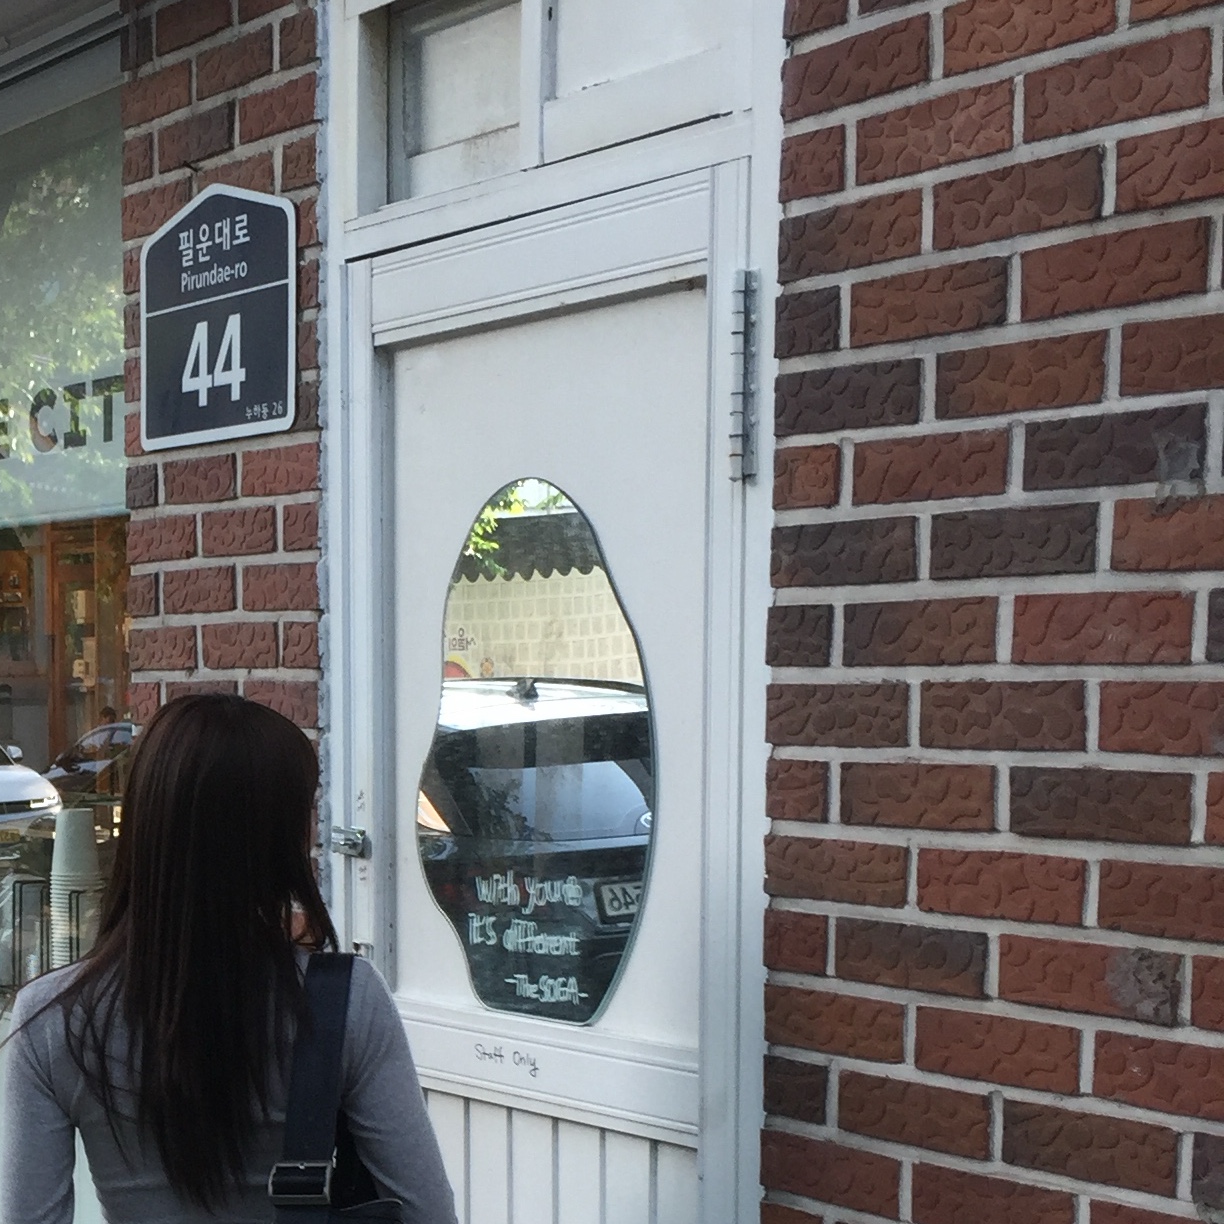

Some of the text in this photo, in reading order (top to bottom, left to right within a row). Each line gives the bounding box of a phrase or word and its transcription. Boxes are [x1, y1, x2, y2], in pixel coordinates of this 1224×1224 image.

[178, 213, 251, 267] 필운대로
[181, 260, 248, 293] Pirundae-ro
[181, 312, 246, 408] 44
[272, 401, 284, 416] 26
[474, 1043, 540, 1077] Staff Only
